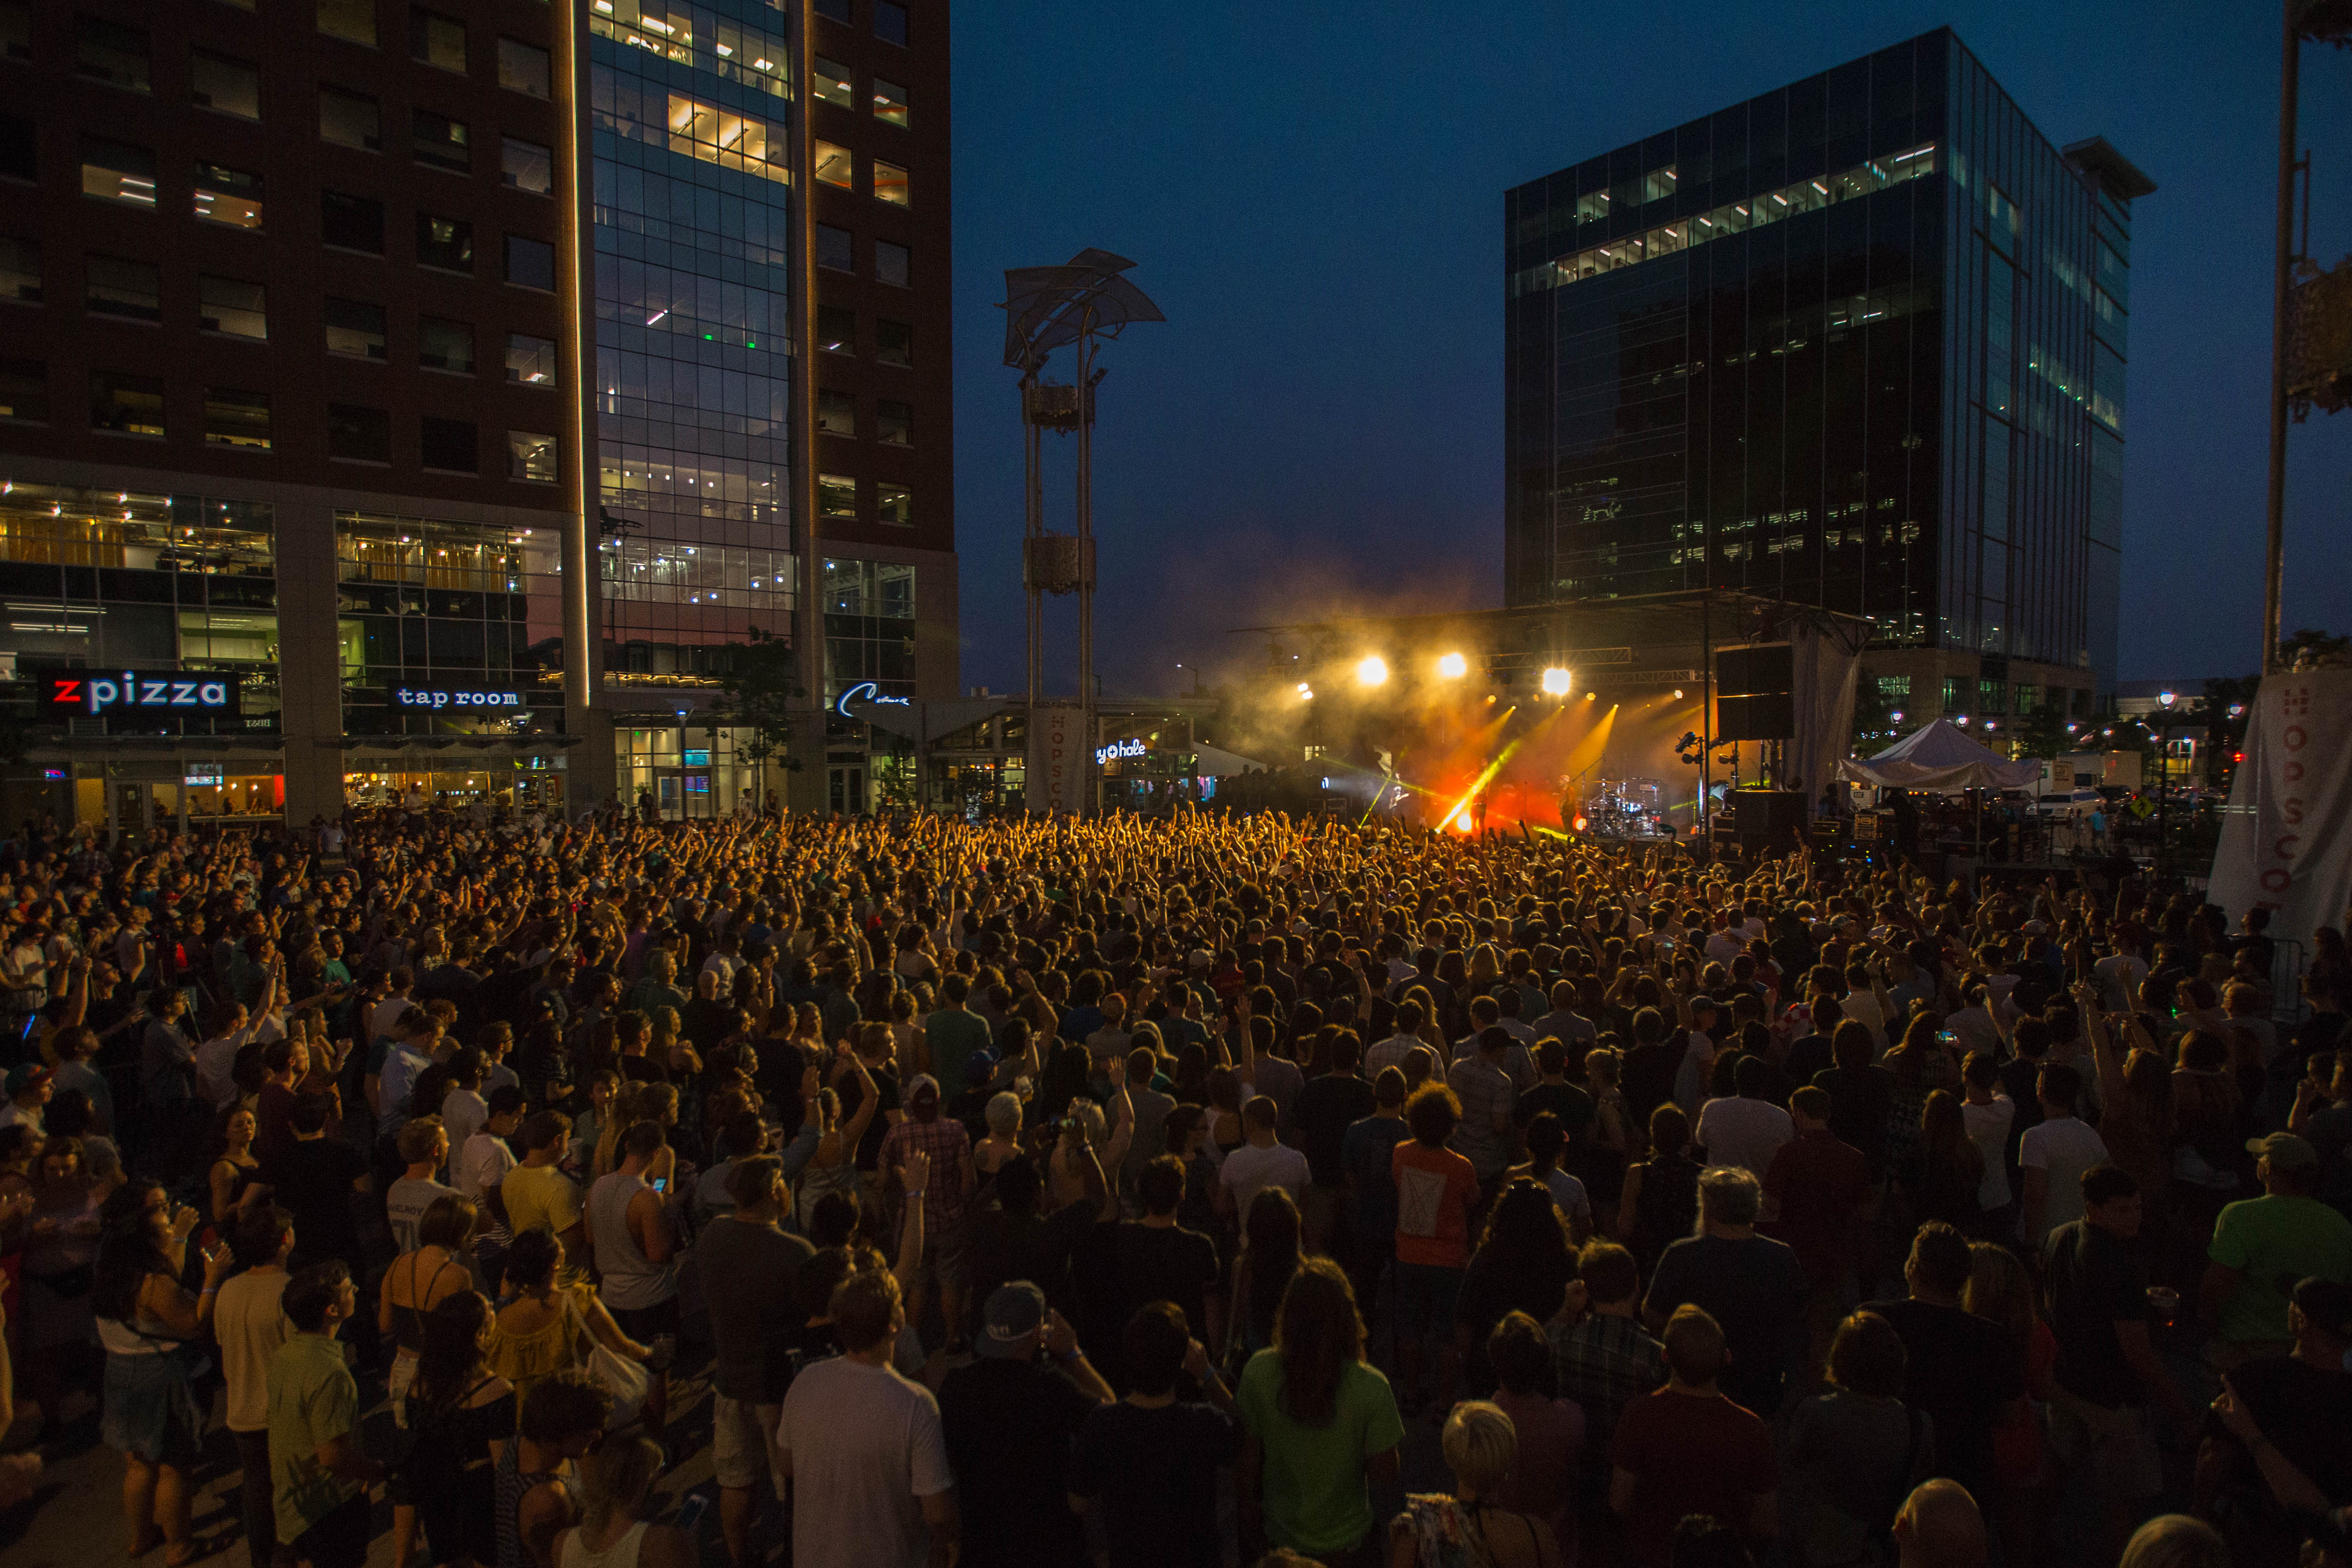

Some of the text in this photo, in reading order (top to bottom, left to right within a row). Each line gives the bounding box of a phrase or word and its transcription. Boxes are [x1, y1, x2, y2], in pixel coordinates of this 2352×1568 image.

[53, 670, 226, 715] z pizza
[398, 688, 519, 708] tap room
